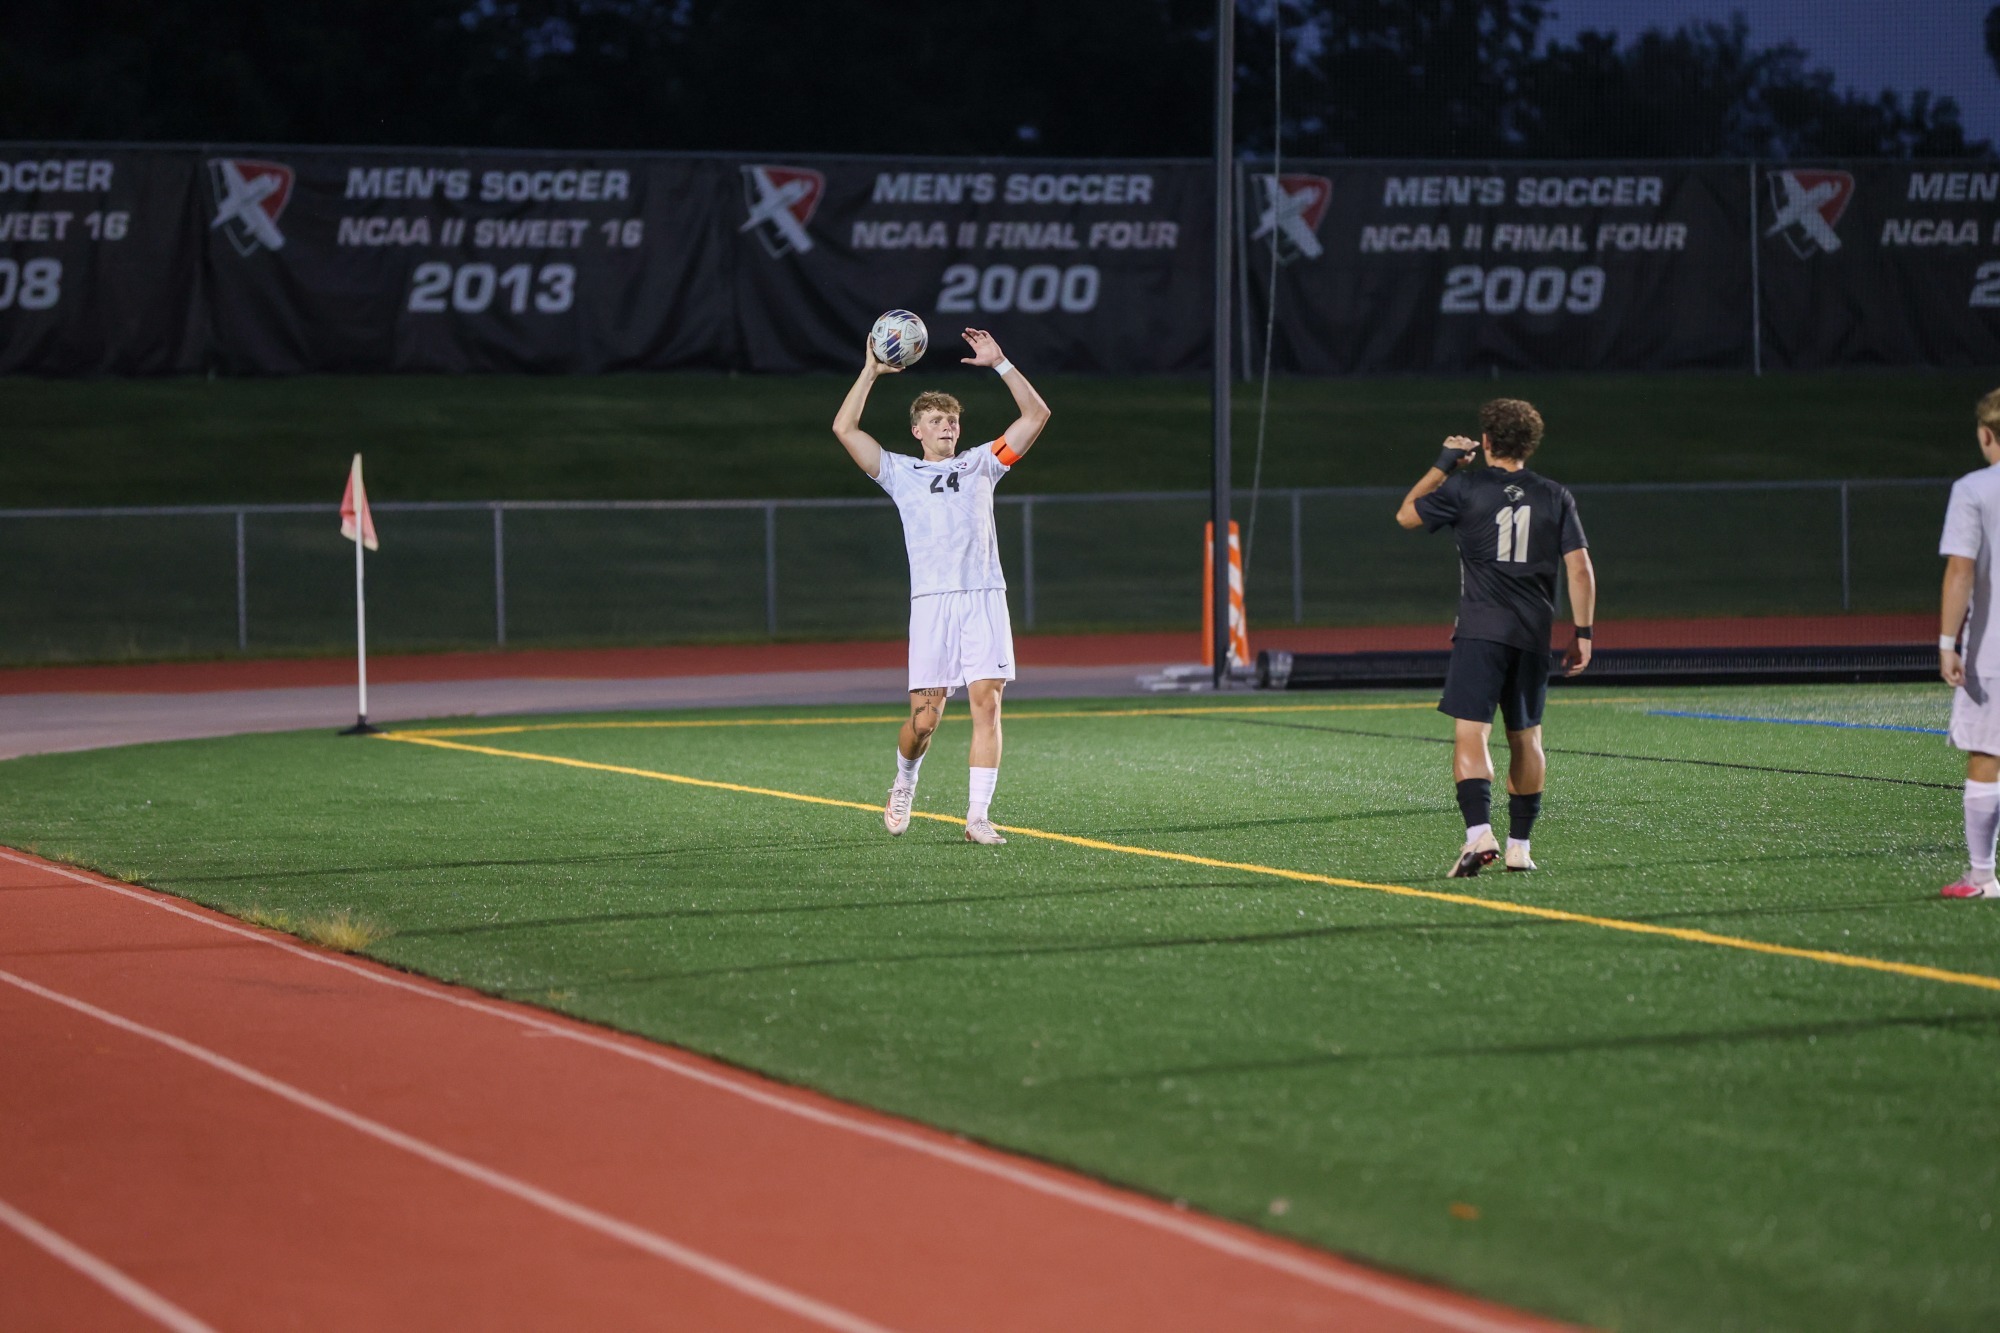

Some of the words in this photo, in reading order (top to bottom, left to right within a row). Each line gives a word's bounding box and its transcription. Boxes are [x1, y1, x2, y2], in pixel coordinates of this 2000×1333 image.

[345, 167, 471, 201] MEN'S
[480, 169, 630, 203] SOCCER
[872, 172, 996, 204] MEN'S
[1004, 173, 1154, 204] SOCCER
[1382, 176, 1505, 208] MEN'S
[1515, 176, 1664, 207] SOCCER
[85, 211, 130, 241] 16
[337, 217, 431, 247] NCAA
[474, 218, 590, 248] SWEET
[601, 219, 644, 248] 16
[851, 220, 948, 250] NCAA
[957, 222, 978, 249] II
[984, 221, 1080, 250] FINAL
[1088, 221, 1179, 250] FOUR
[1359, 223, 1451, 253] NCAA
[1462, 223, 1483, 251] II
[1492, 223, 1588, 252] FINAL
[1596, 223, 1688, 252] FOUR
[1880, 218, 1979, 247] NCAA
[408, 262, 576, 314] 2013
[936, 264, 1100, 314] 2000
[1440, 265, 1606, 315] 2009
[929, 471, 960, 494] 24
[1495, 505, 1531, 563] 11
